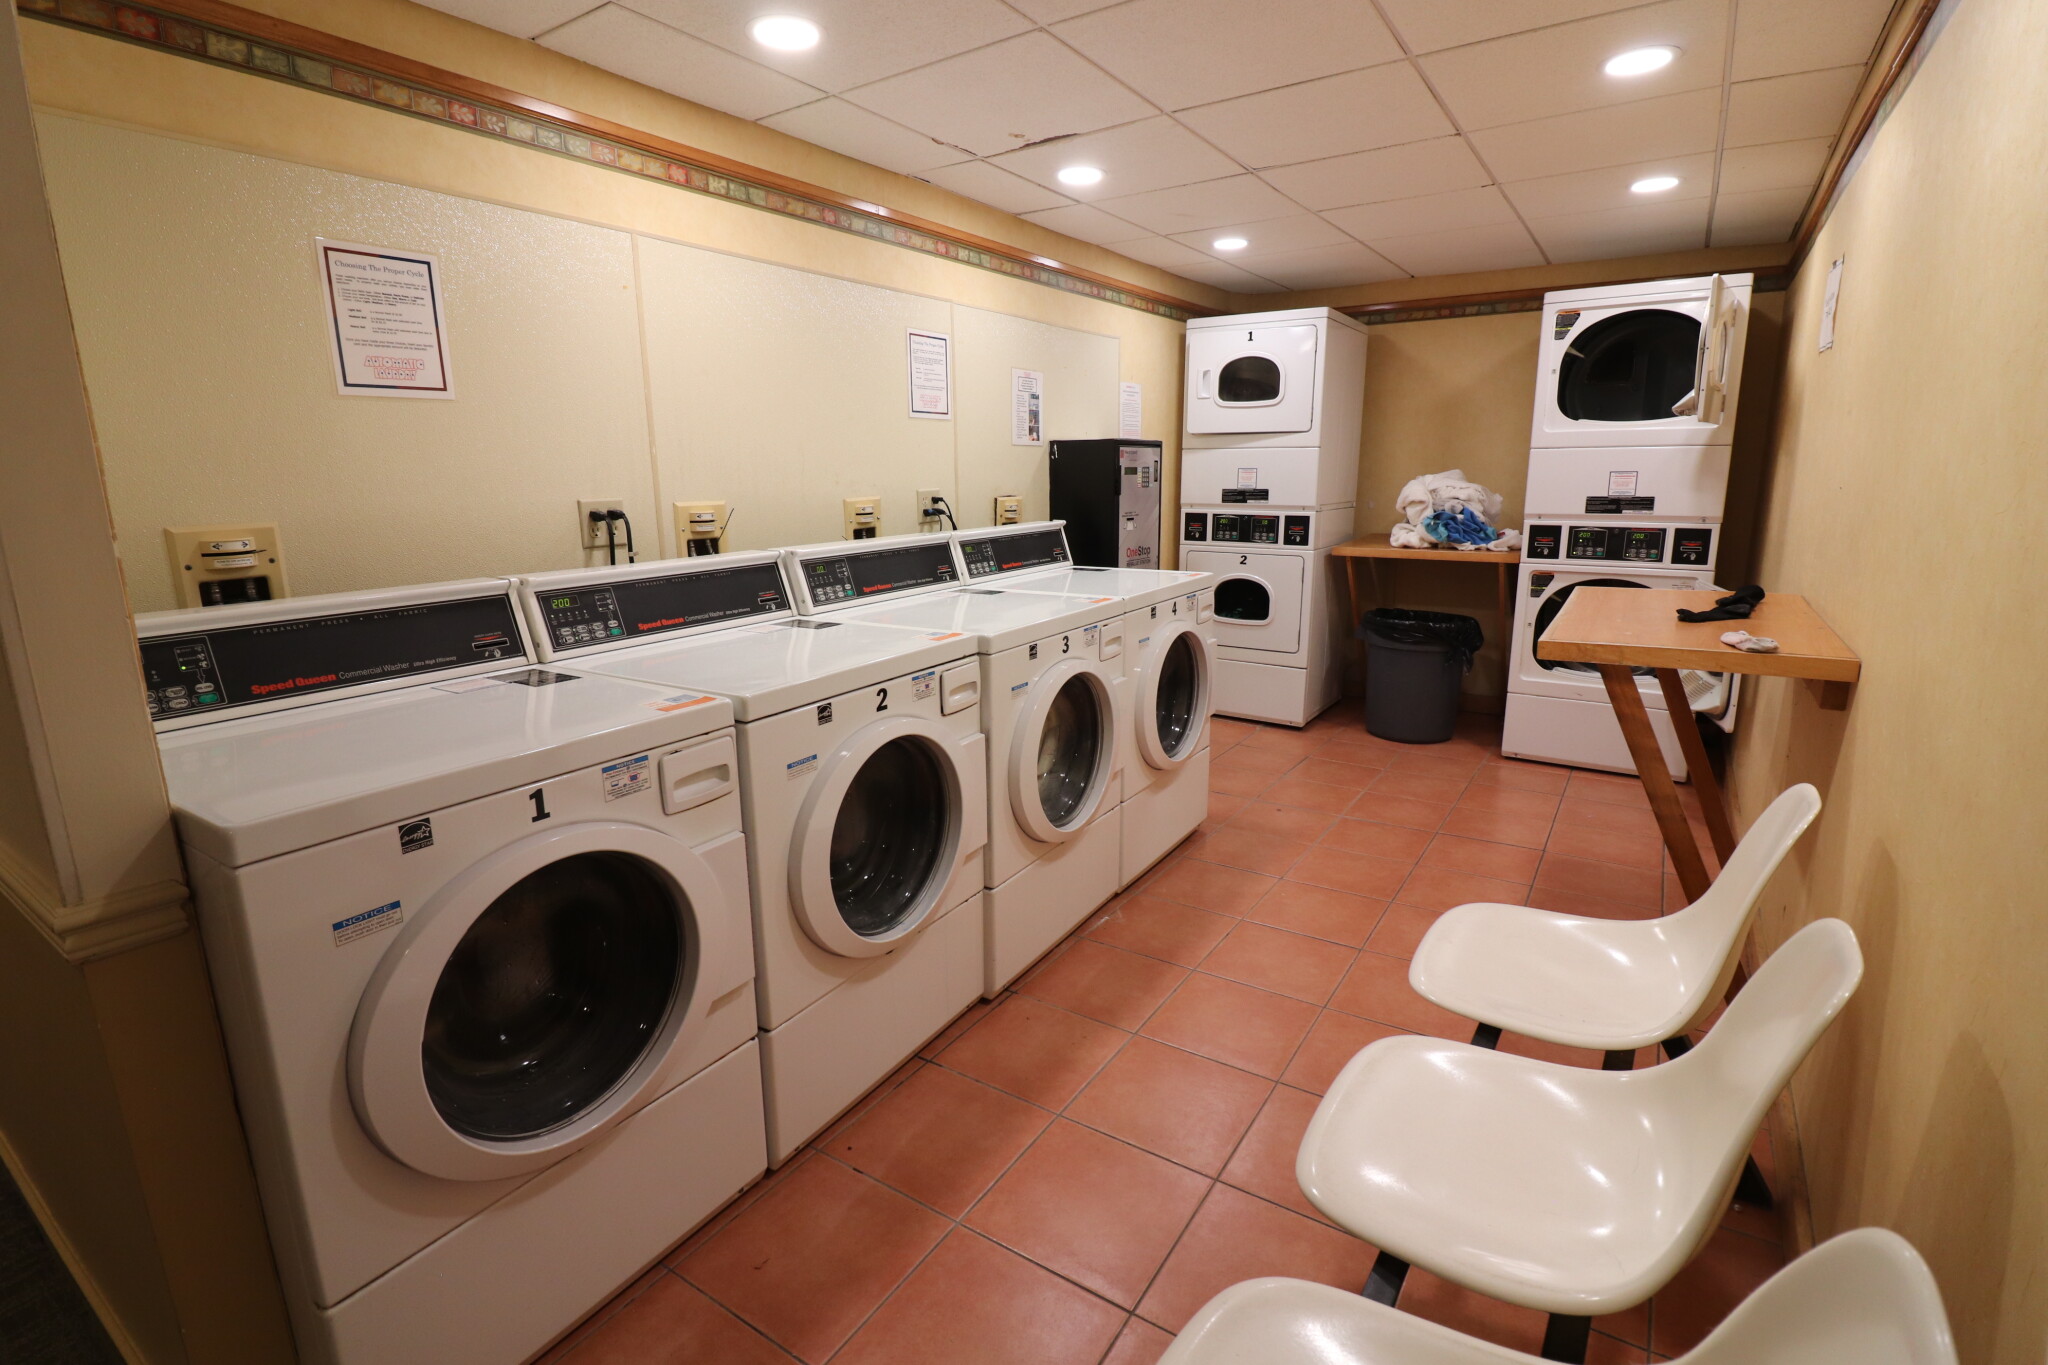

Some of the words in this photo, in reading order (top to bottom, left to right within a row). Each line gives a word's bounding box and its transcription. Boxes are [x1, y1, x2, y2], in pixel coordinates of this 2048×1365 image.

[334, 260, 367, 271] Choosing
[368, 264, 382, 272] The
[383, 266, 405, 276] Proper
[406, 270, 424, 278] Cycle
[1248, 332, 1254, 342] 1
[364, 356, 424, 370] AUTOMATIC
[374, 368, 417, 381] LAUNDRY
[1126, 546, 1151, 558] OneStop
[1240, 555, 1248, 565] 2
[552, 598, 570, 609] 200
[1172, 601, 1177, 616] 4
[253, 624, 310, 634] PERMANENT
[398, 608, 428, 616] FABRIC
[638, 620, 661, 630] Speed
[661, 617, 684, 626] Queen
[685, 613, 709, 622] Commercial
[1062, 636, 1070, 653] 3
[251, 679, 294, 695] Speed
[296, 674, 337, 687] Queen
[339, 666, 382, 680] Commercial
[383, 662, 410, 672] Washer
[876, 688, 888, 712] 2
[529, 788, 551, 823] 1
[342, 904, 391, 927] NOTICE
